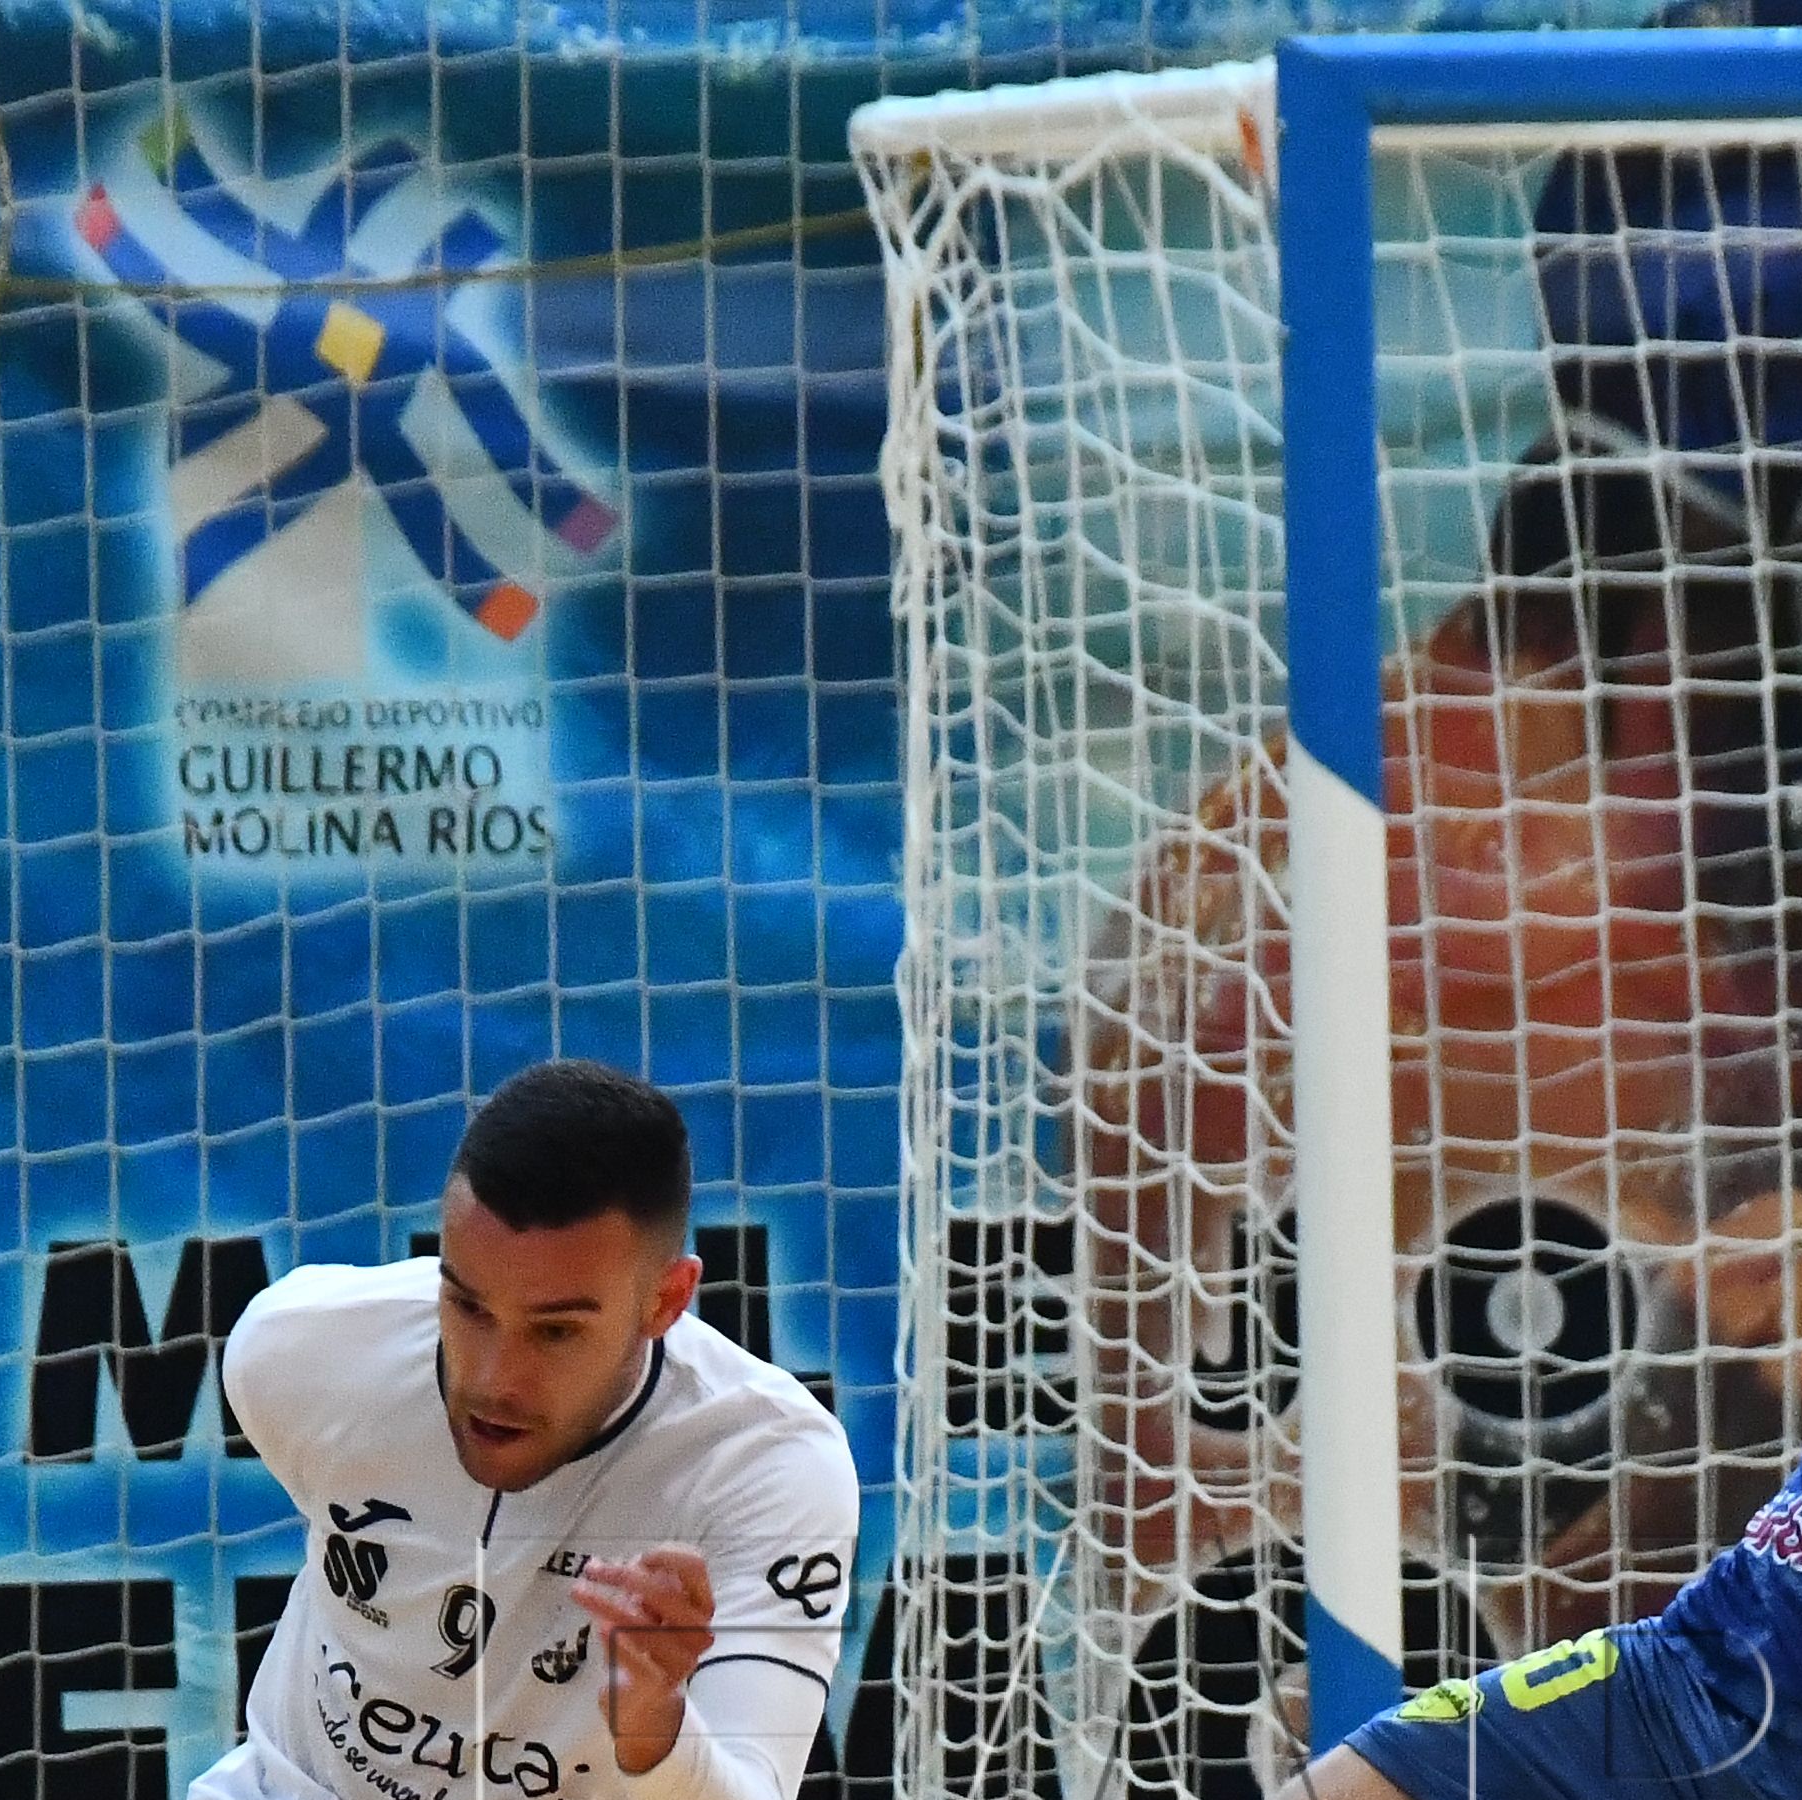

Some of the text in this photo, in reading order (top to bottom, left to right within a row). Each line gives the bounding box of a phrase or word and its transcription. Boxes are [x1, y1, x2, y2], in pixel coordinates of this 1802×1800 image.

[179, 744, 503, 796] GUILLERMO
[182, 805, 403, 857] MOLINA
[430, 1584, 497, 1680] 9
